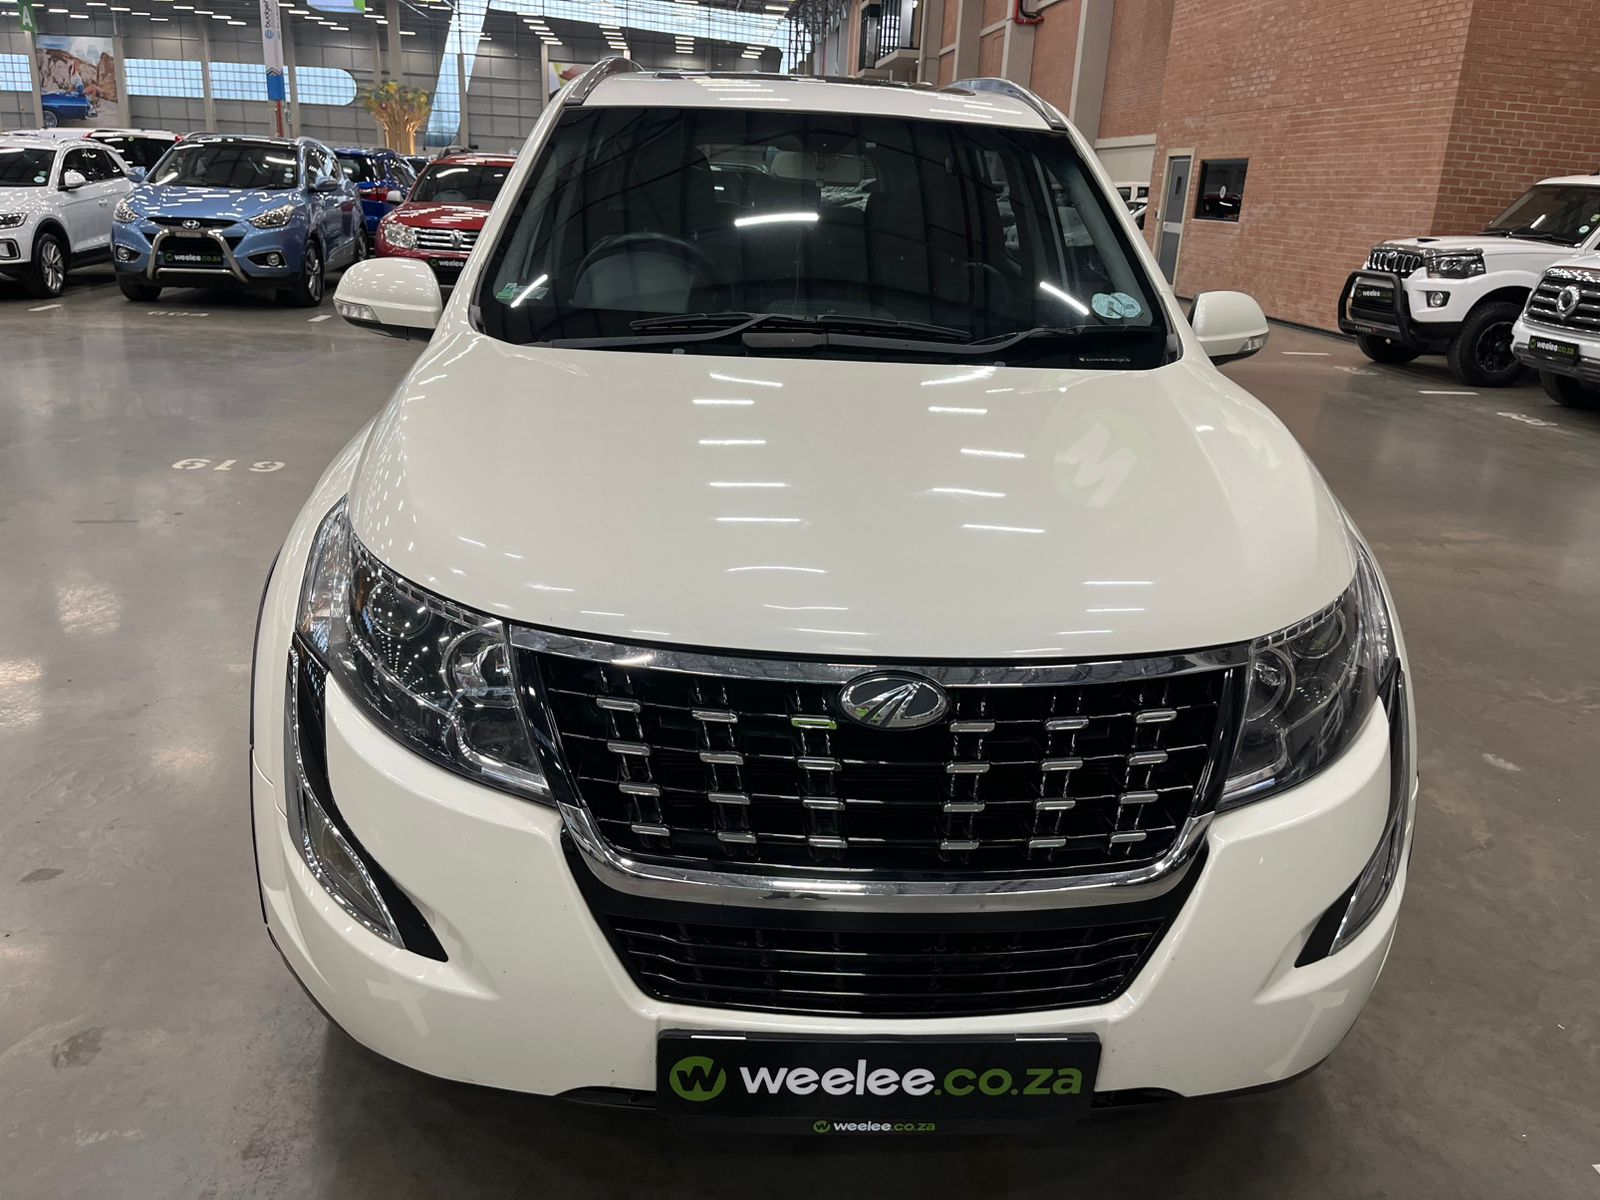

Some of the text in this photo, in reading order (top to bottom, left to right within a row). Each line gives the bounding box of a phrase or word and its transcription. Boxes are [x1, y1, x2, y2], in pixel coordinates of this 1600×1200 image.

[23, 5, 33, 27] A
[739, 1059, 1083, 1097] weelee.co.za
[833, 1119, 936, 1133] weelee.co.za
